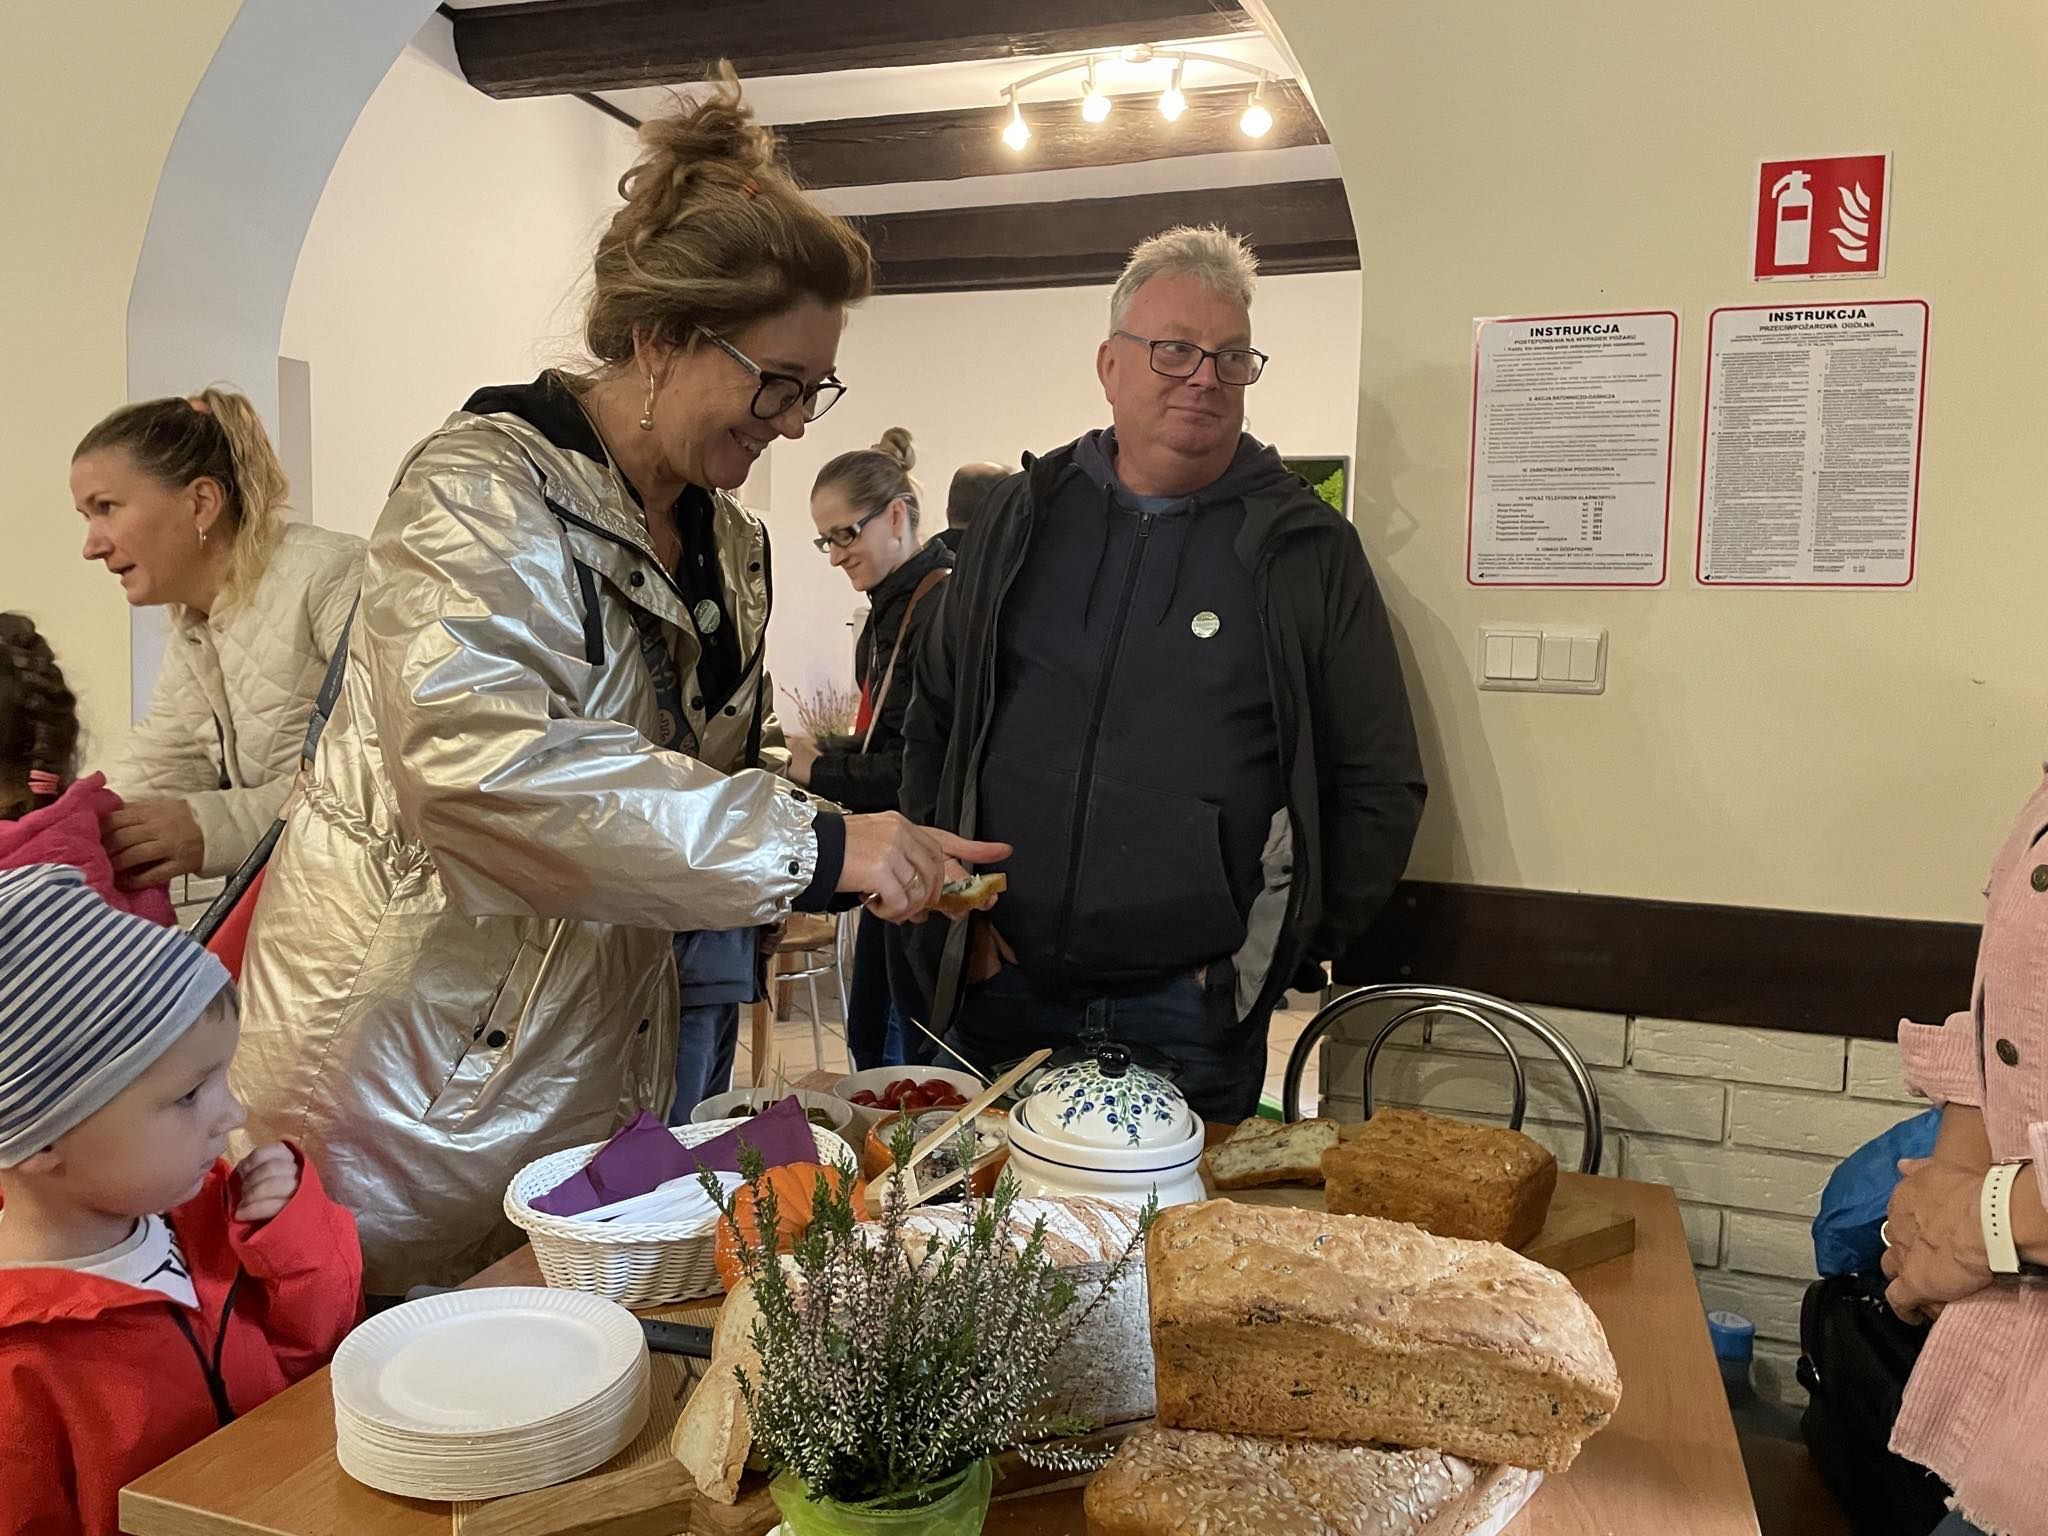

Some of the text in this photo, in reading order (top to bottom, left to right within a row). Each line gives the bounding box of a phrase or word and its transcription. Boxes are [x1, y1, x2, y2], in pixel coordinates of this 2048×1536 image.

[1769, 309, 1867, 322] INSTRUKCJA
[1530, 324, 1620, 337] INSTRUKCJA
[1760, 321, 1875, 331] PRZECIWPOŻAROWA OGÓLNA
